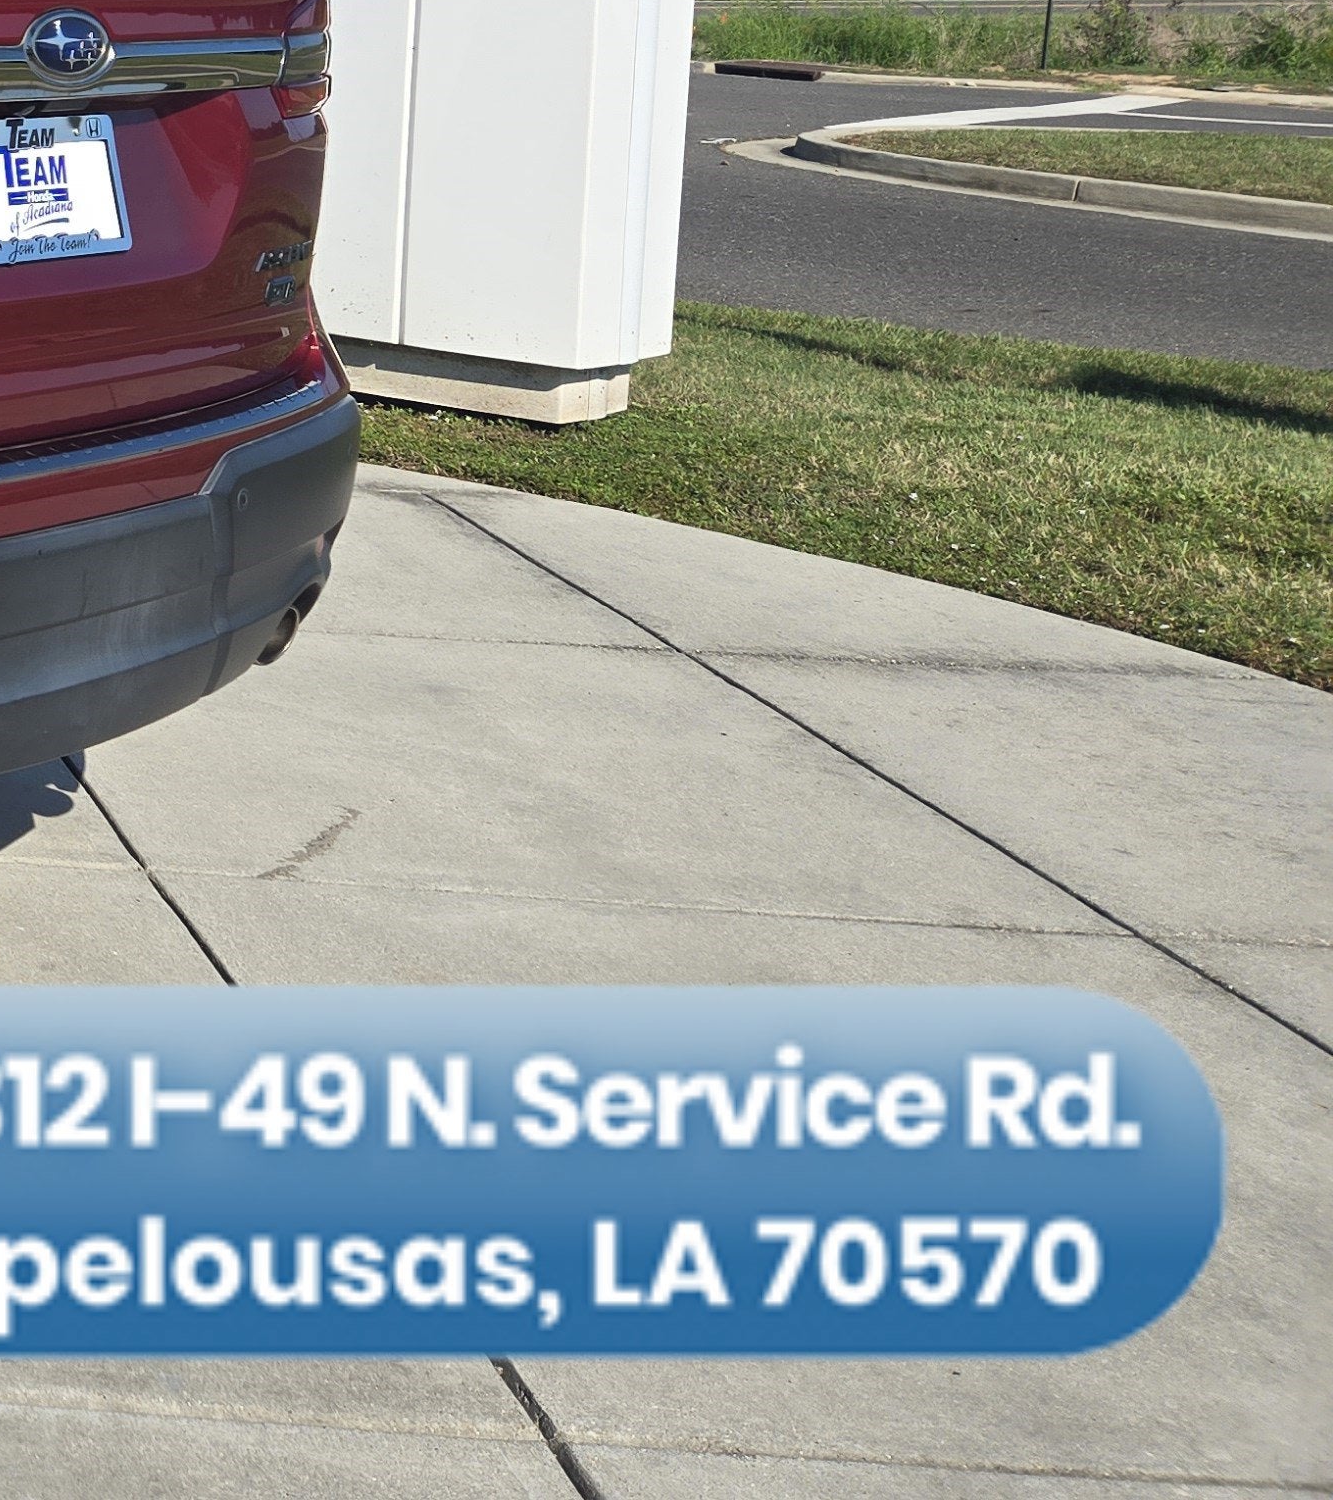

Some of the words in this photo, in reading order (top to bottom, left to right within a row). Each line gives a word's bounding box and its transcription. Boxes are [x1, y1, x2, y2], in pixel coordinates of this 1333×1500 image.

[5, 118, 55, 149] TEAM
[22, 200, 73, 225] Acadiana
[8, 238, 35, 263] Join
[35, 236, 56, 255] The
